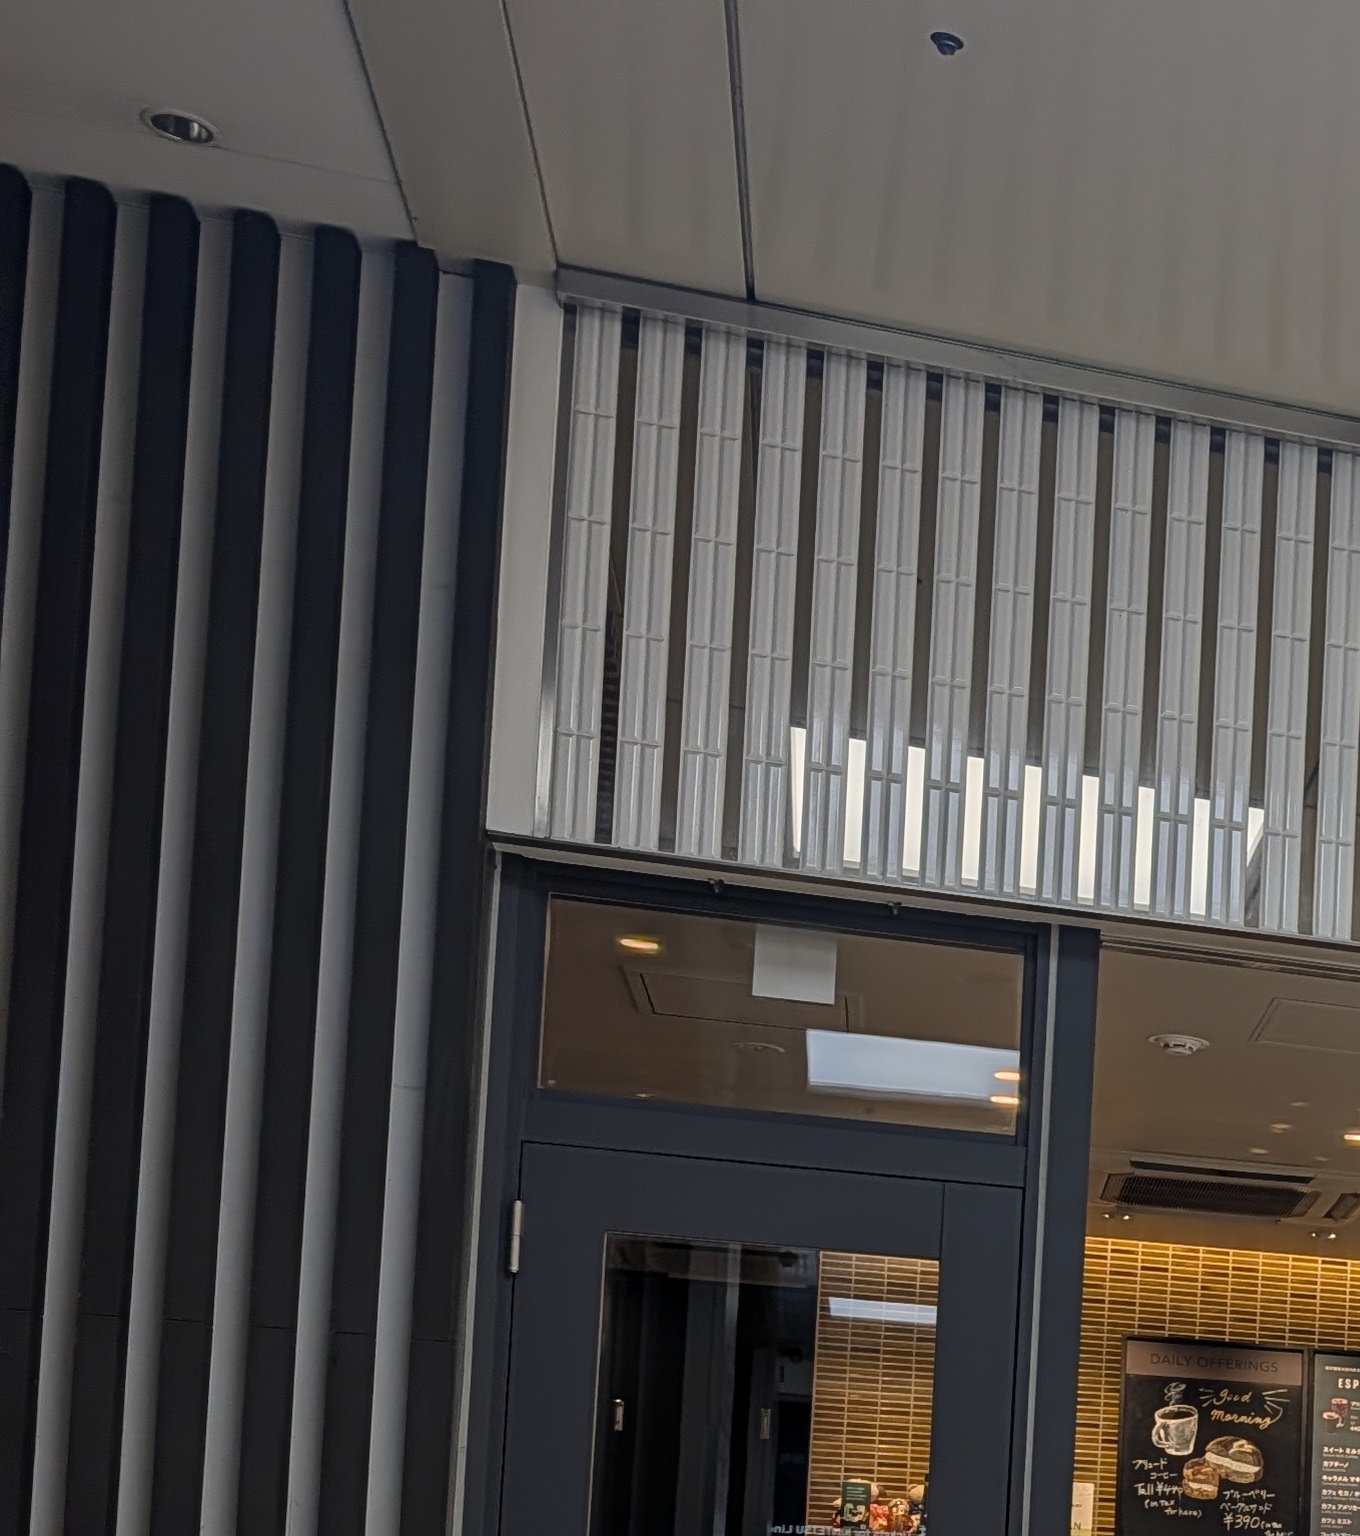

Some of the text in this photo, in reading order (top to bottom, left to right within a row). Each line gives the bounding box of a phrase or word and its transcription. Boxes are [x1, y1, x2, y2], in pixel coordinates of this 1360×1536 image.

[1151, 1353, 1279, 1373] DAILY OFFERINGS
[1223, 1513, 1260, 1531] ¥390
